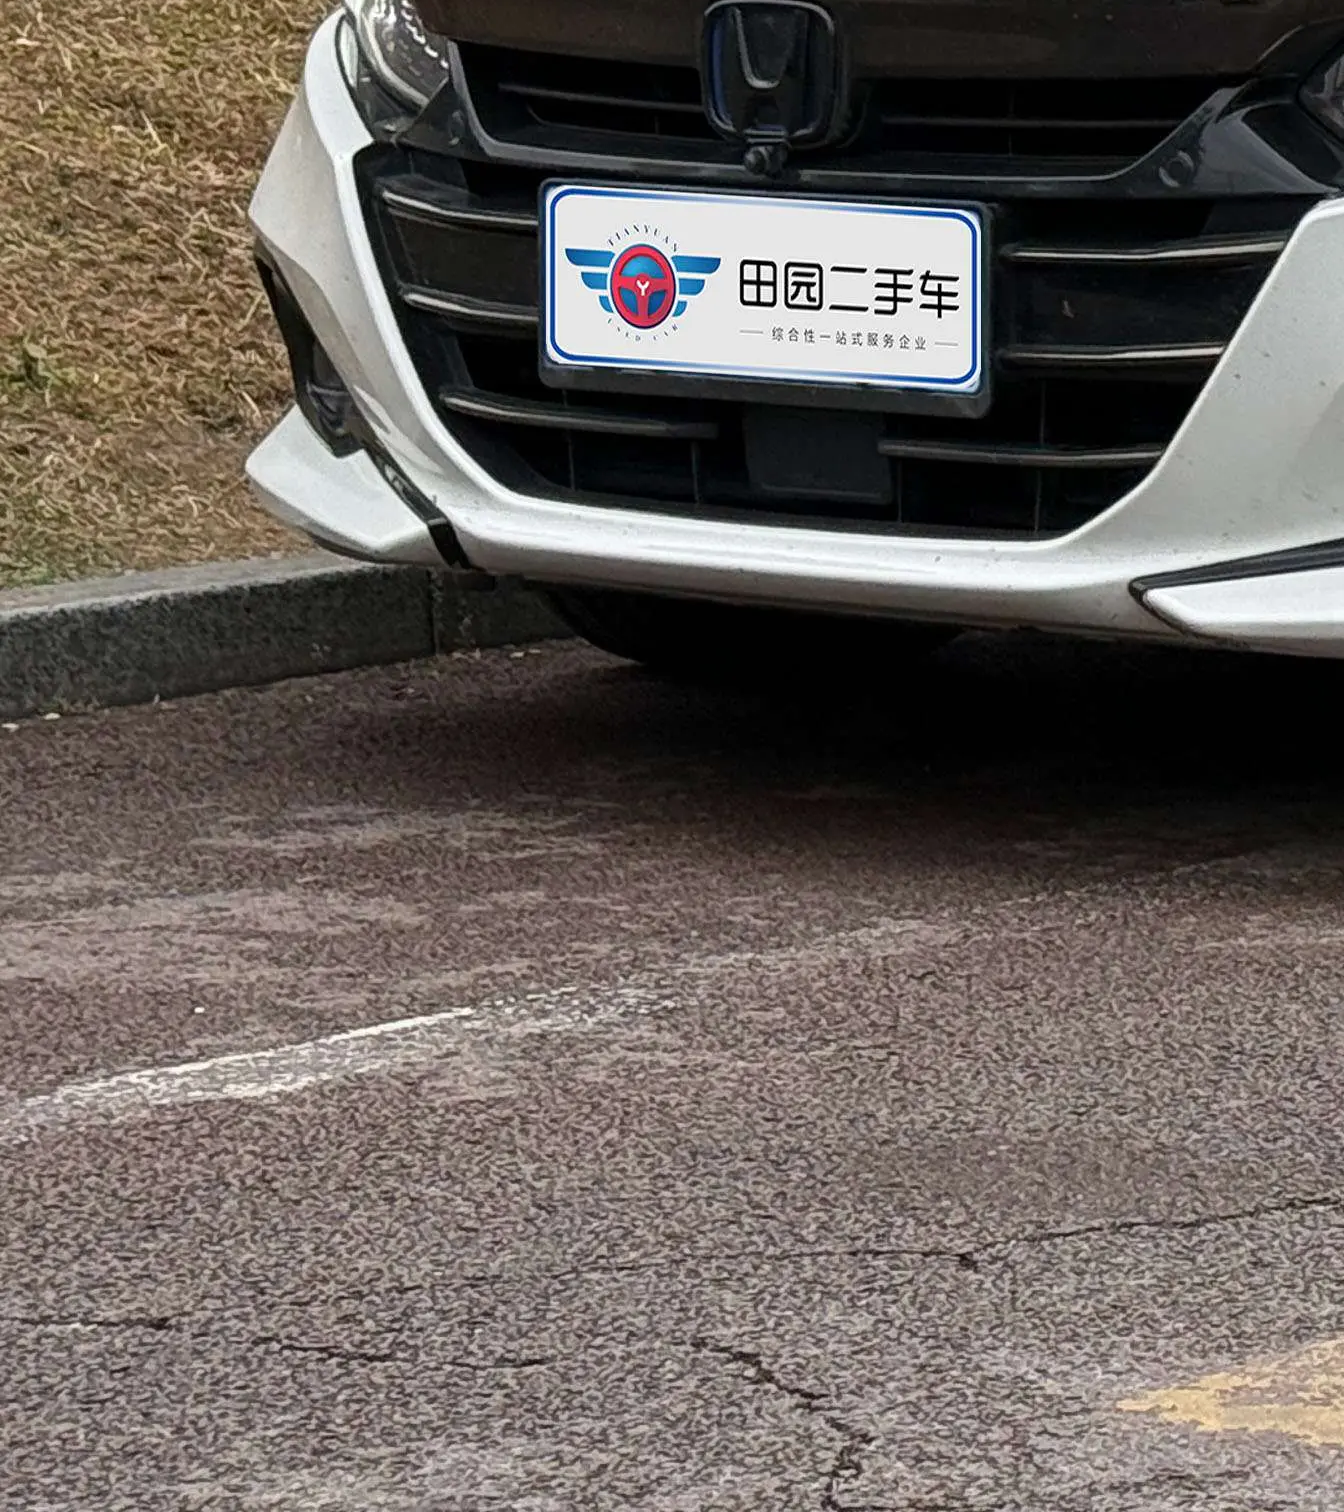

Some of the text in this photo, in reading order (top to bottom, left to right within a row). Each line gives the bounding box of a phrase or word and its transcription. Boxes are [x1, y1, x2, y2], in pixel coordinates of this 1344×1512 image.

[739, 258, 960, 319] 田园二手车
[771, 326, 927, 351] 综合性一站式服务企业
